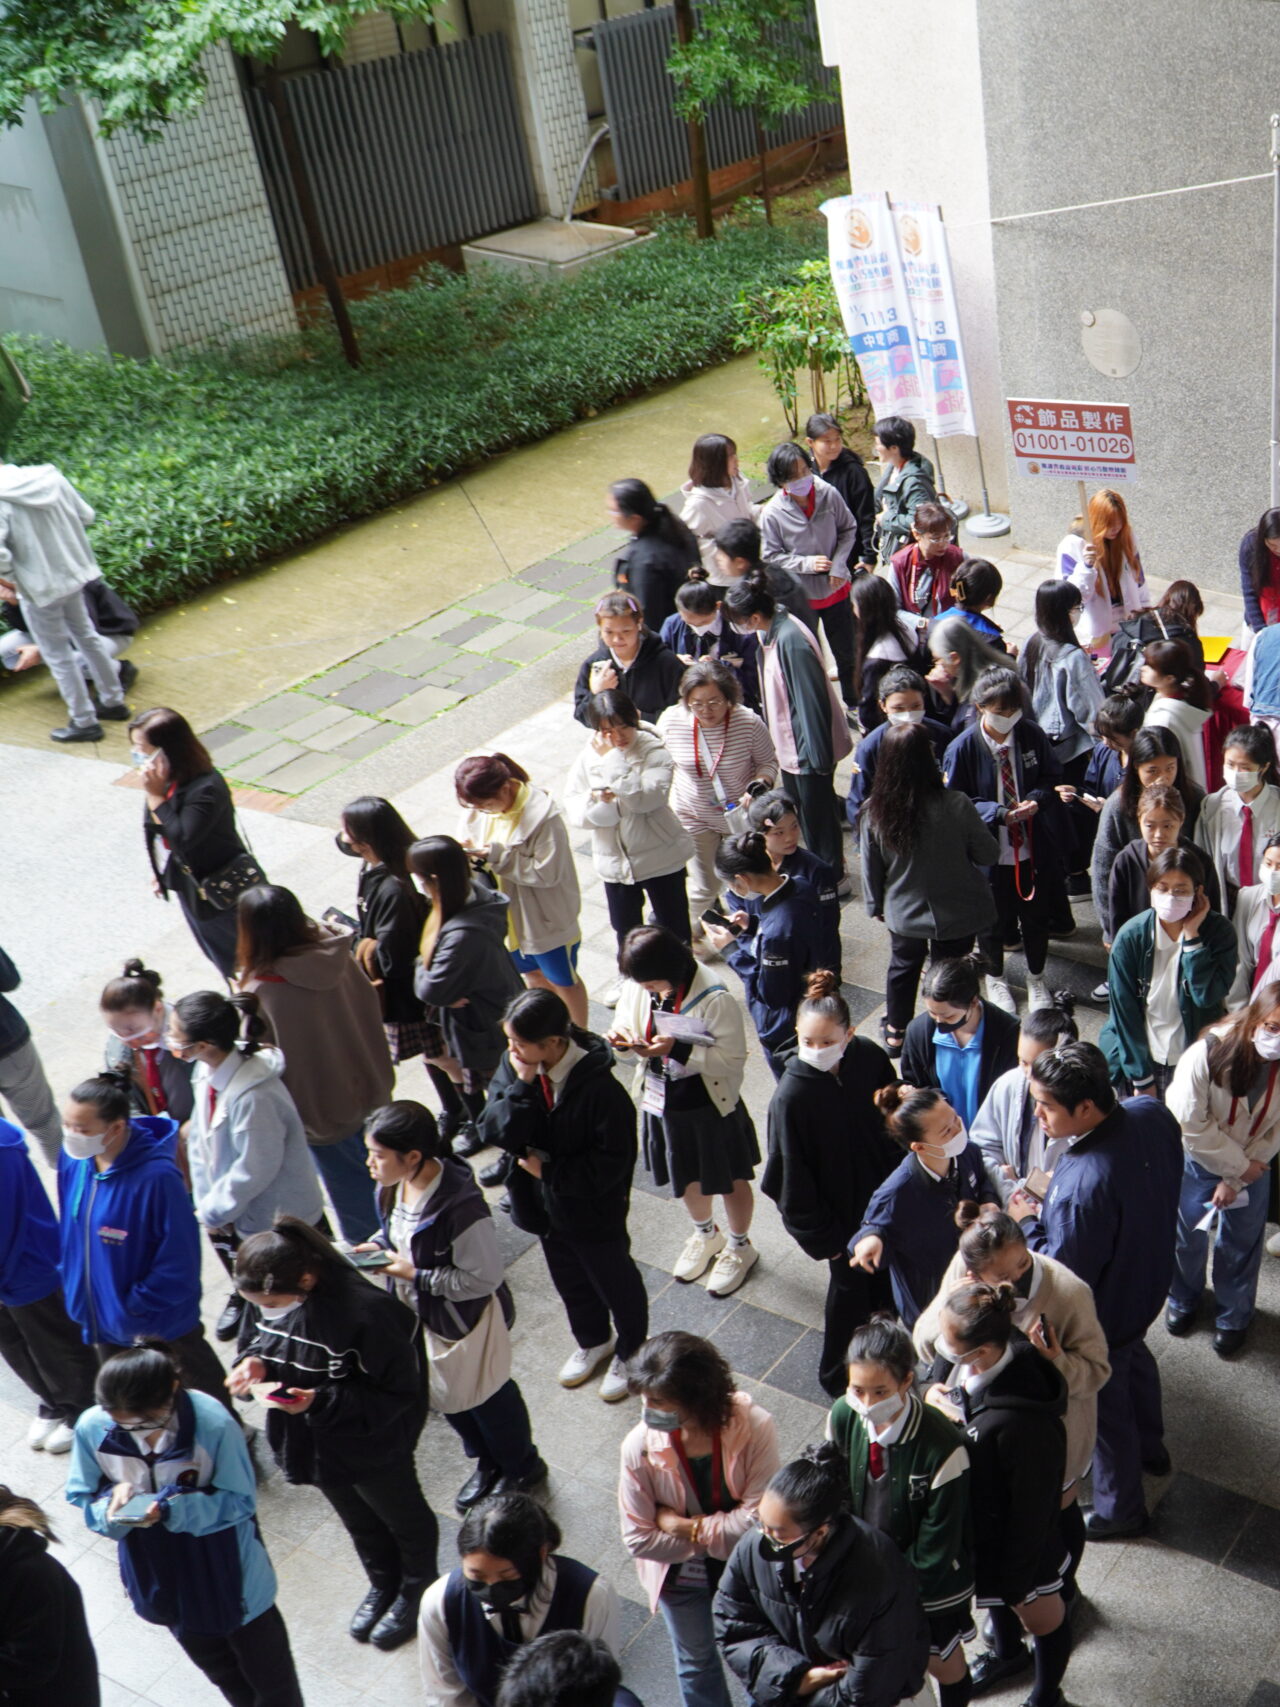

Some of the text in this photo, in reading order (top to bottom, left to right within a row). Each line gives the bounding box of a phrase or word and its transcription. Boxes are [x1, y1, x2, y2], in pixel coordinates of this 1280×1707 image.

[1037, 408, 1124, 431] 飾品製作
[1016, 433, 1130, 454] 01001-01026
